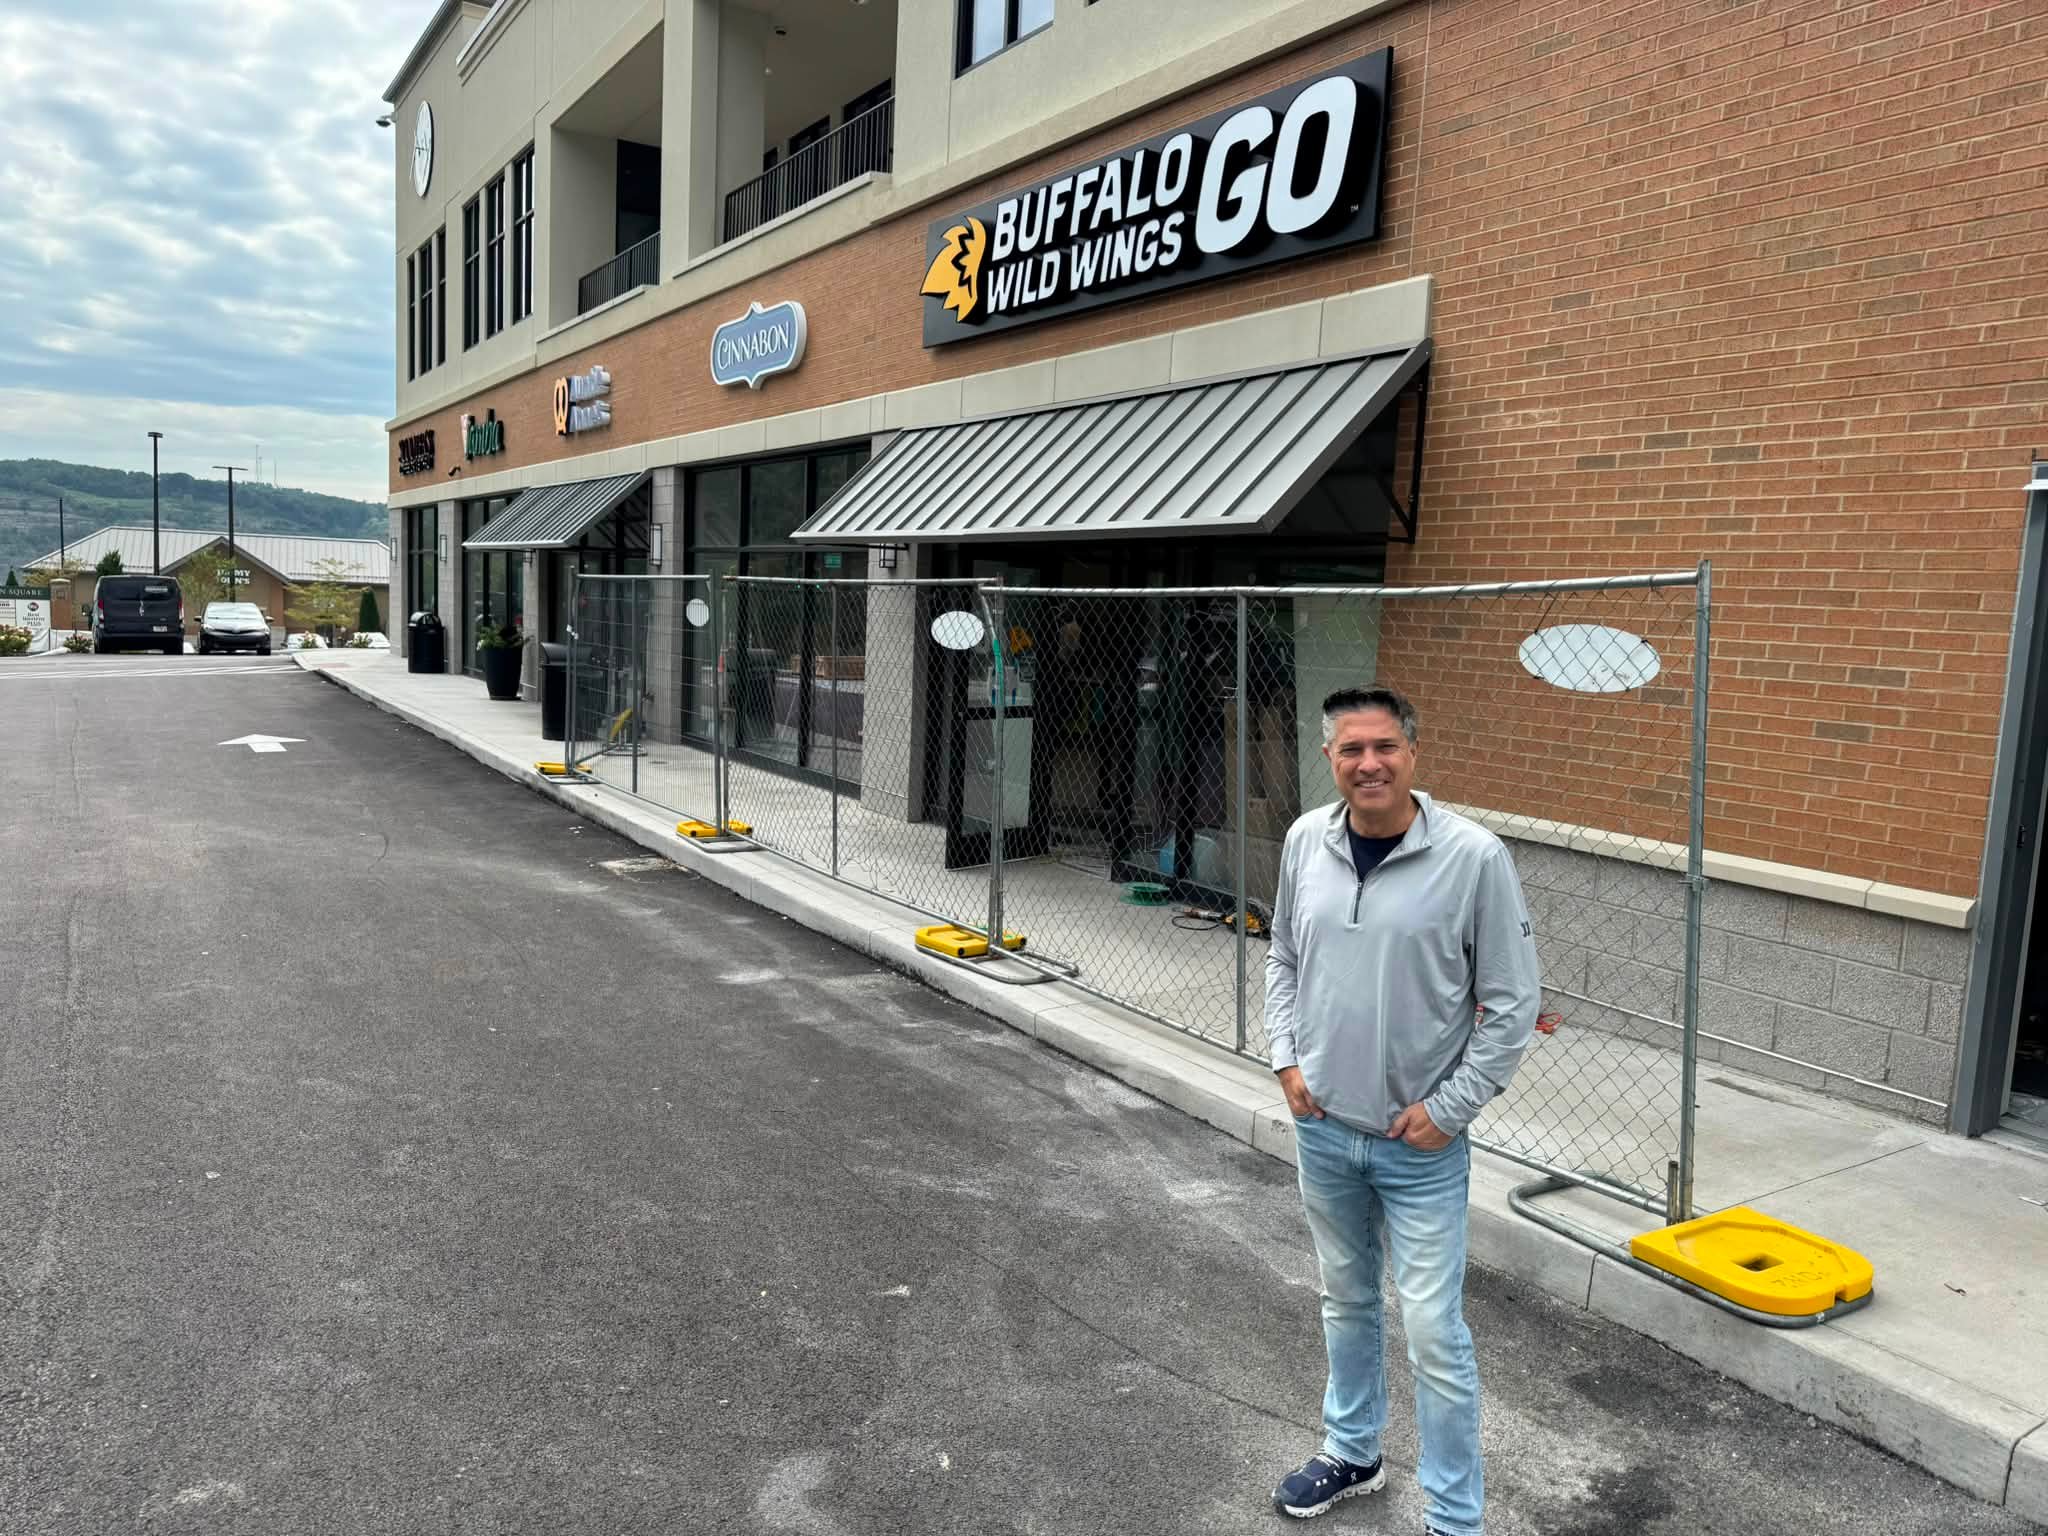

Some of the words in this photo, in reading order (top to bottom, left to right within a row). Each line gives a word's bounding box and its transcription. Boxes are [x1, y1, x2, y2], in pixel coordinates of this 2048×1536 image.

[992, 132, 1192, 262] BUFFALO
[1195, 75, 1358, 254] GO
[987, 250, 1061, 314] WILD
[1069, 211, 1185, 291] WINGS
[717, 320, 789, 370] CINNABON
[216, 569, 251, 577] JIMY
